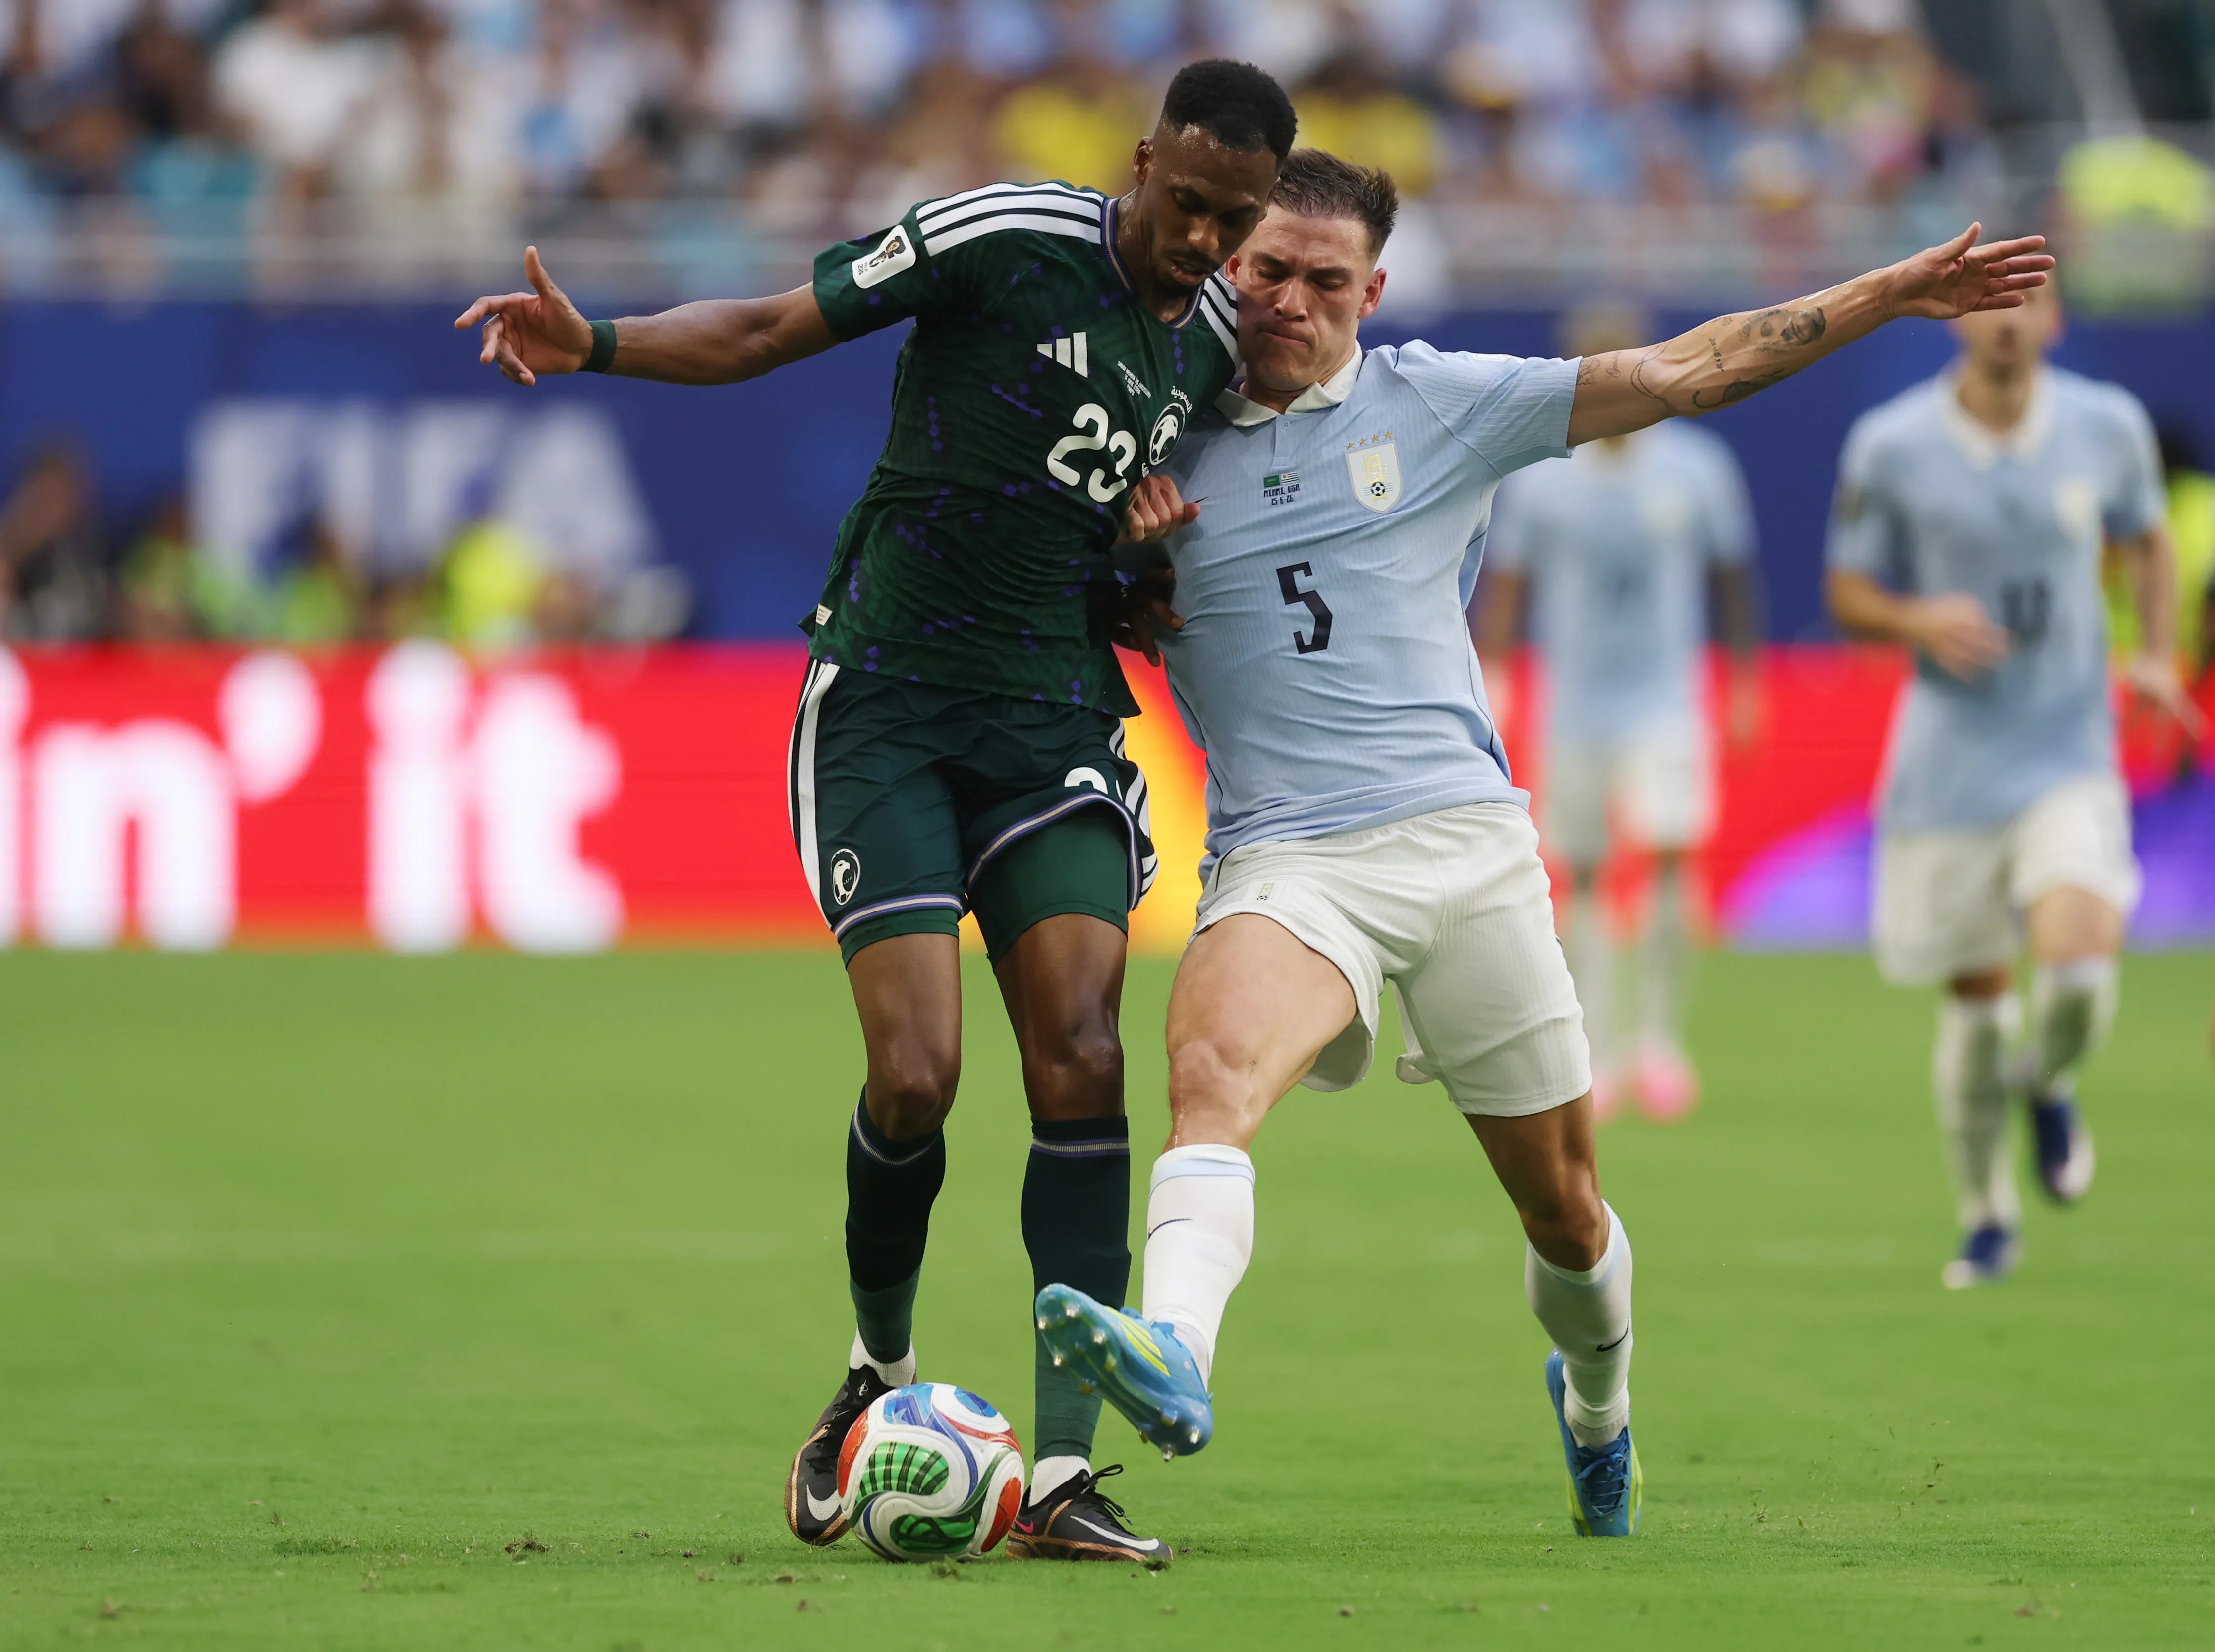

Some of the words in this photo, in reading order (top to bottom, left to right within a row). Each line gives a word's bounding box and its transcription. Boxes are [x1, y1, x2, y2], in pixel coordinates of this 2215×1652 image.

[191, 394, 664, 590] FIFA
[1047, 403, 1136, 503] 23
[1288, 484, 1300, 493] USA
[1275, 561, 1333, 654] 5
[364, 637, 625, 953] it
